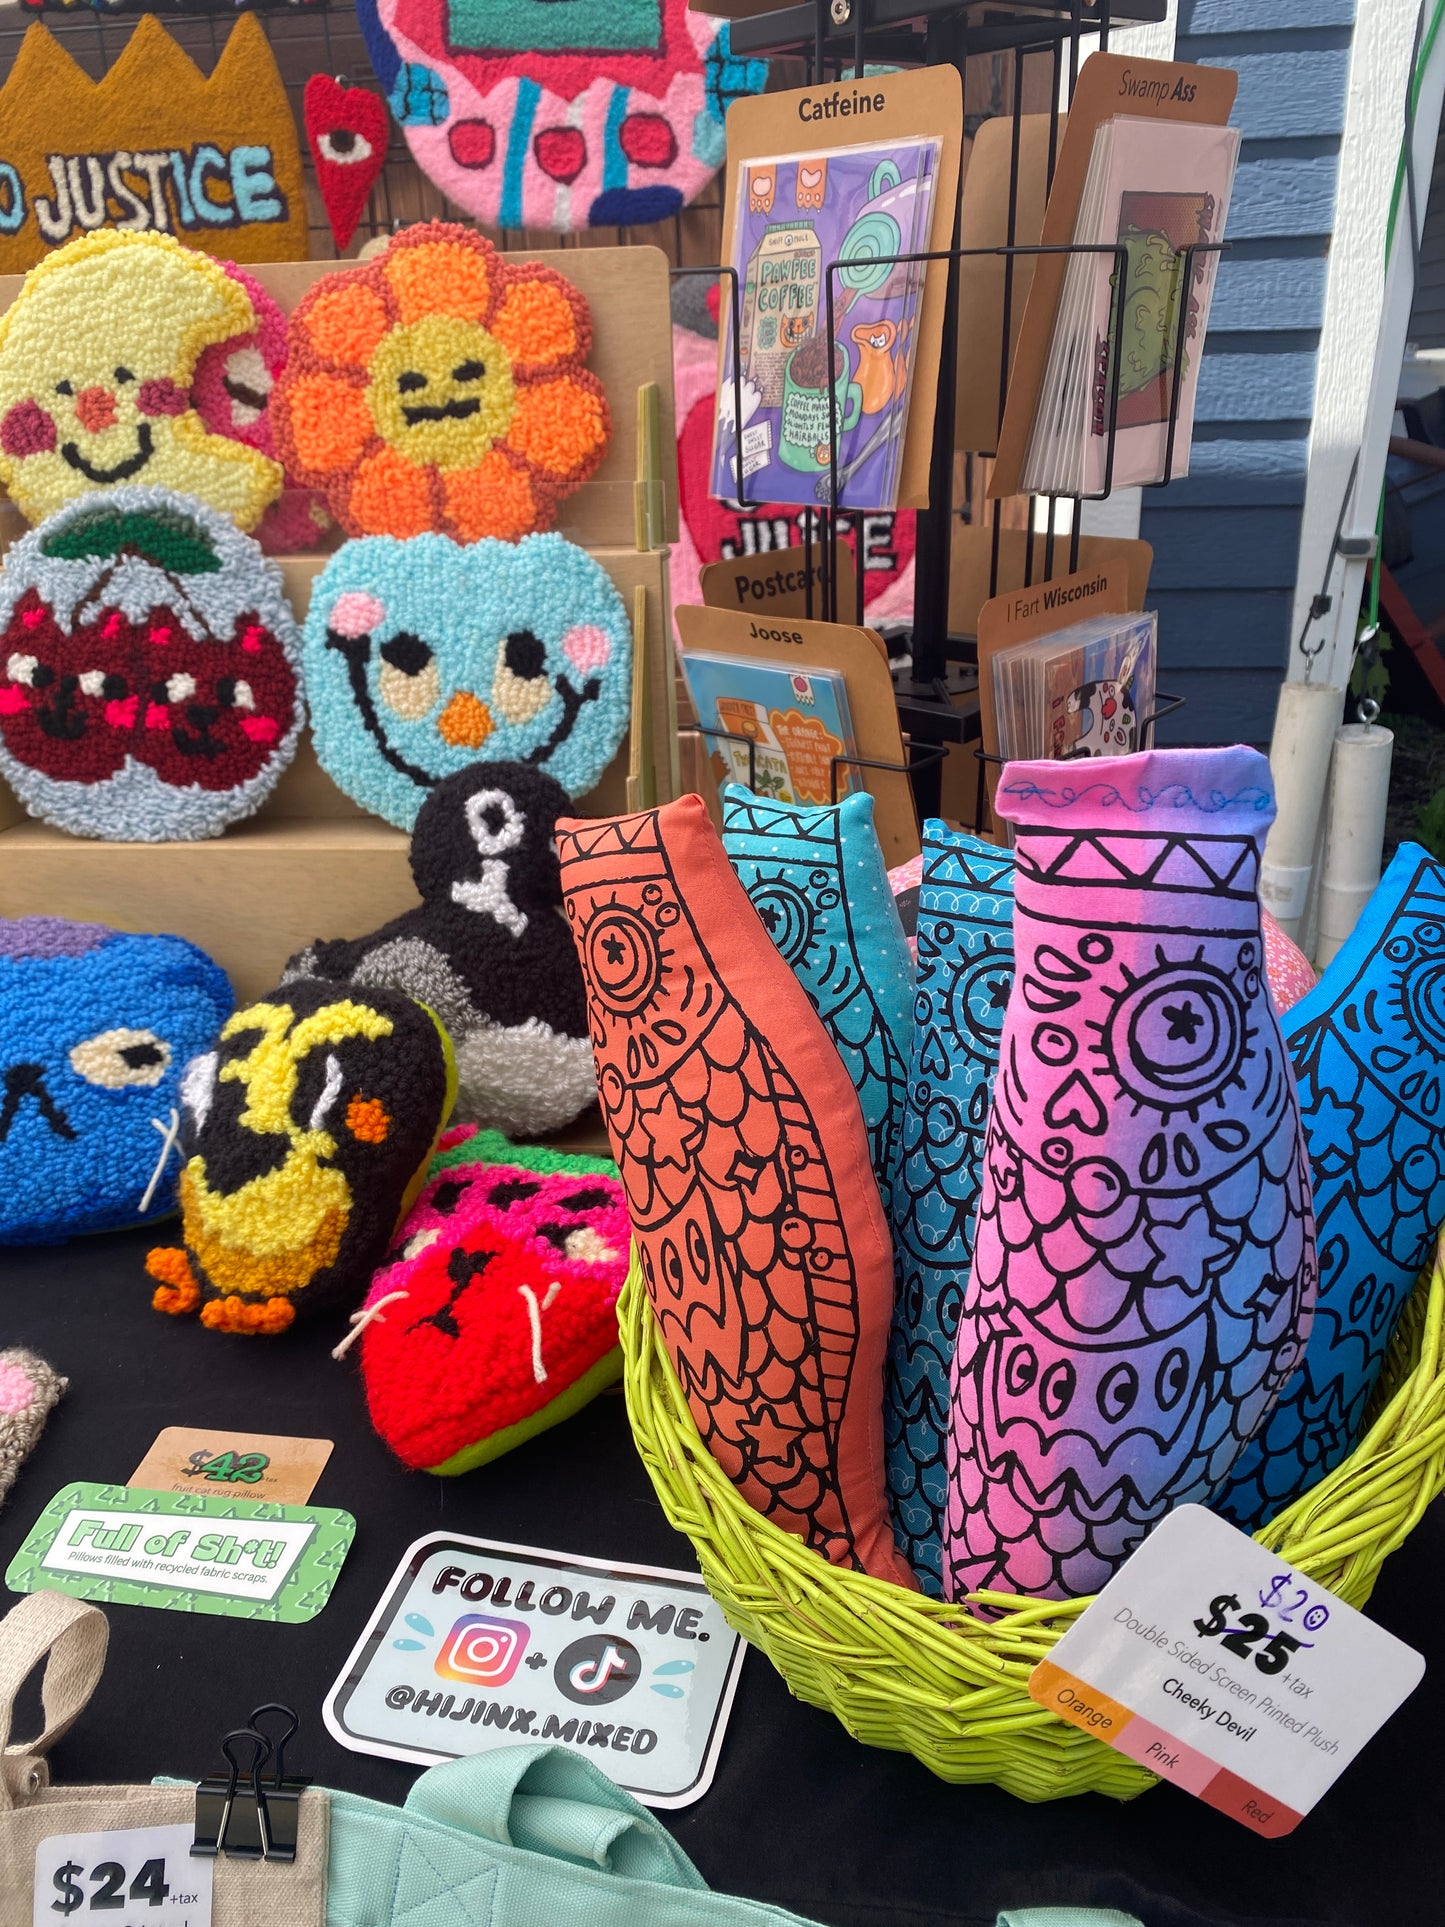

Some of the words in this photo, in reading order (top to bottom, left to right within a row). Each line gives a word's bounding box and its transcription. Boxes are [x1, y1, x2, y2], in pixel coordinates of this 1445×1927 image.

[798, 89, 886, 122] Catfeine
[1118, 69, 1170, 107] Swamp
[1170, 76, 1198, 102] Ass
[34, 143, 285, 241] JUSTICE
[760, 258, 817, 287] PAWFEE
[758, 283, 815, 312] COFFEE
[1007, 603, 1011, 623] I
[1014, 600, 1040, 621] Fart
[1043, 575, 1108, 611] Wisconsin
[749, 622, 804, 644] Joose
[181, 1449, 270, 1484] $42
[171, 1483, 194, 1492] fruit
[213, 1489, 232, 1498] rug
[232, 1490, 266, 1499] pillow
[67, 1519, 144, 1553] Full
[144, 1530, 192, 1557] of
[68, 1551, 104, 1564] Pillows
[104, 1554, 131, 1567] filled
[131, 1558, 154, 1570] with
[155, 1562, 199, 1577] recycled
[199, 1566, 231, 1580] fabric
[231, 1571, 269, 1585] scraps.
[430, 1565, 616, 1626] FOLLOW
[626, 1599, 711, 1643] ME.
[1193, 1593, 1302, 1676] $25
[1281, 1672, 1315, 1700] +tax
[1113, 1606, 1170, 1649] Double
[1167, 1640, 1216, 1675] Sided
[1209, 1667, 1259, 1705] Screen
[1256, 1696, 1309, 1734] Printed
[1303, 1725, 1340, 1756] Plush
[384, 1684, 659, 1755] @HIJINX.MIXED
[1057, 1688, 1113, 1730] Orange
[1162, 1678, 1217, 1721] Cheeky
[1215, 1710, 1258, 1743] Devil
[1145, 1741, 1180, 1769] Pink
[1241, 1799, 1275, 1825] Red
[50, 1857, 170, 1918] $24
[170, 1893, 199, 1905] +tax
